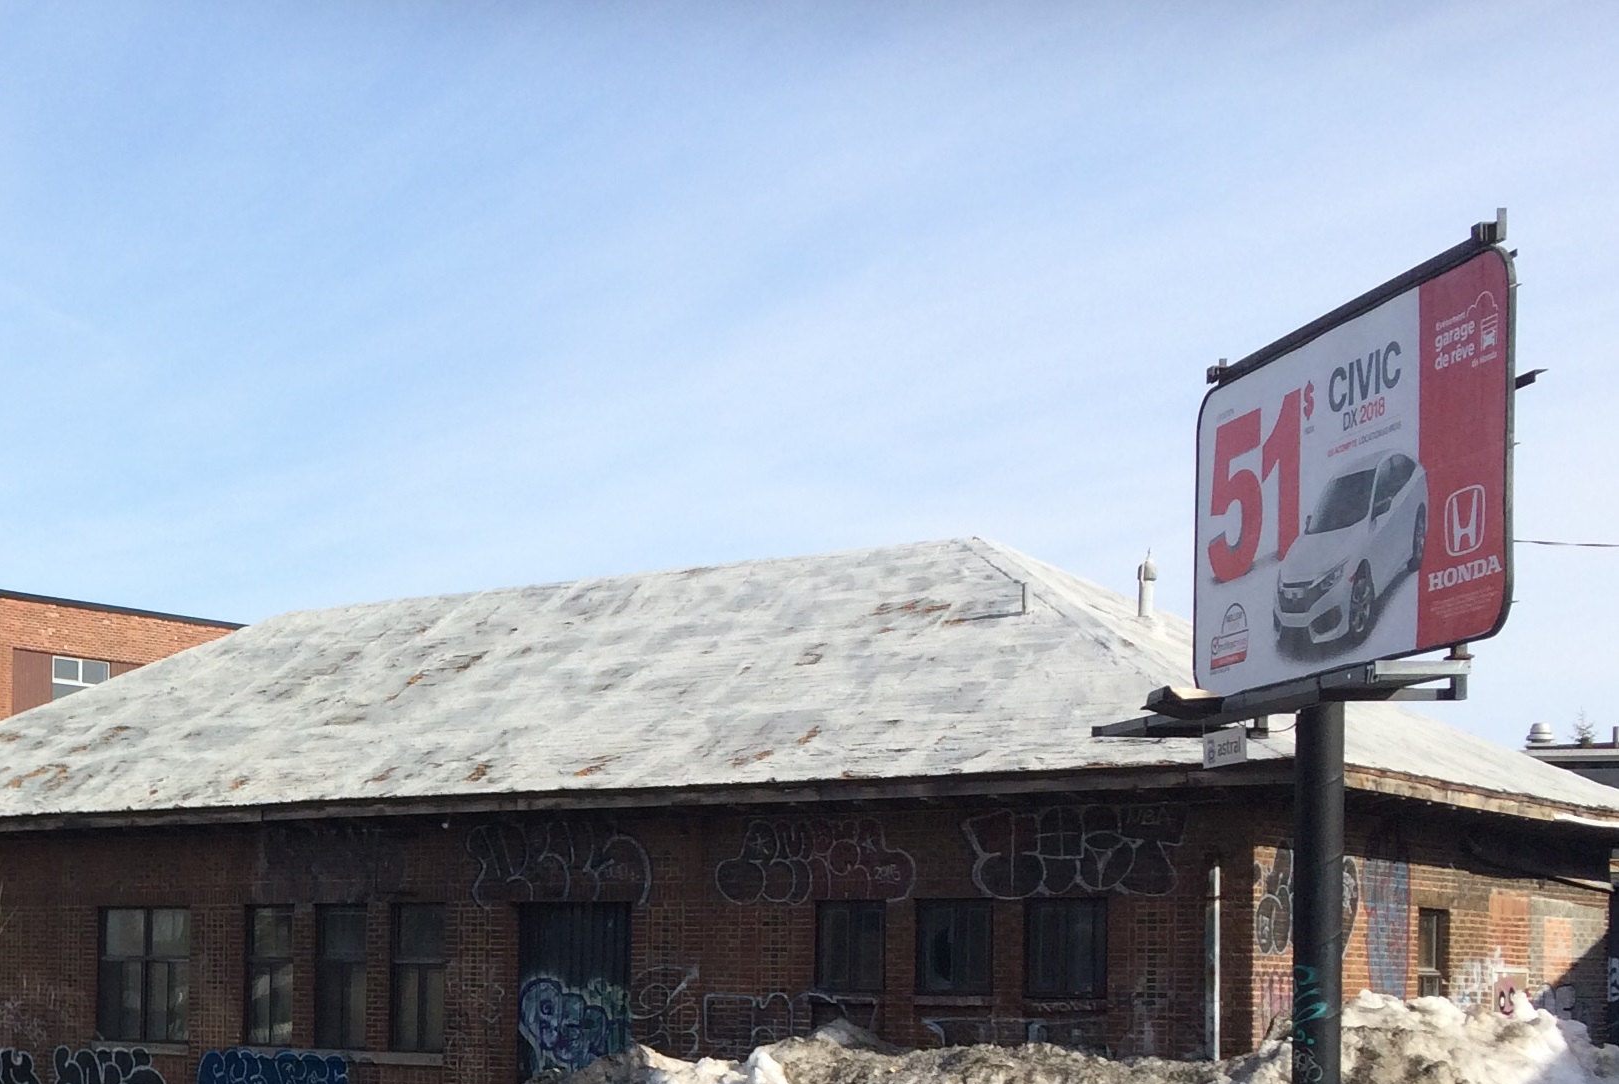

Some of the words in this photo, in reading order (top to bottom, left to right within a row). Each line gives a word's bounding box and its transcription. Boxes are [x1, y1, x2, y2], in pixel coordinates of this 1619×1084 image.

[1435, 320, 1475, 352] garage
[1435, 352, 1449, 370] de
[1451, 343, 1475, 364] rêve
[1328, 340, 1402, 412] CIVIC
[1343, 408, 1358, 431] DX
[1359, 396, 1385, 424] 2018
[1428, 554, 1503, 592] HONDA
[1217, 735, 1242, 757] astral
